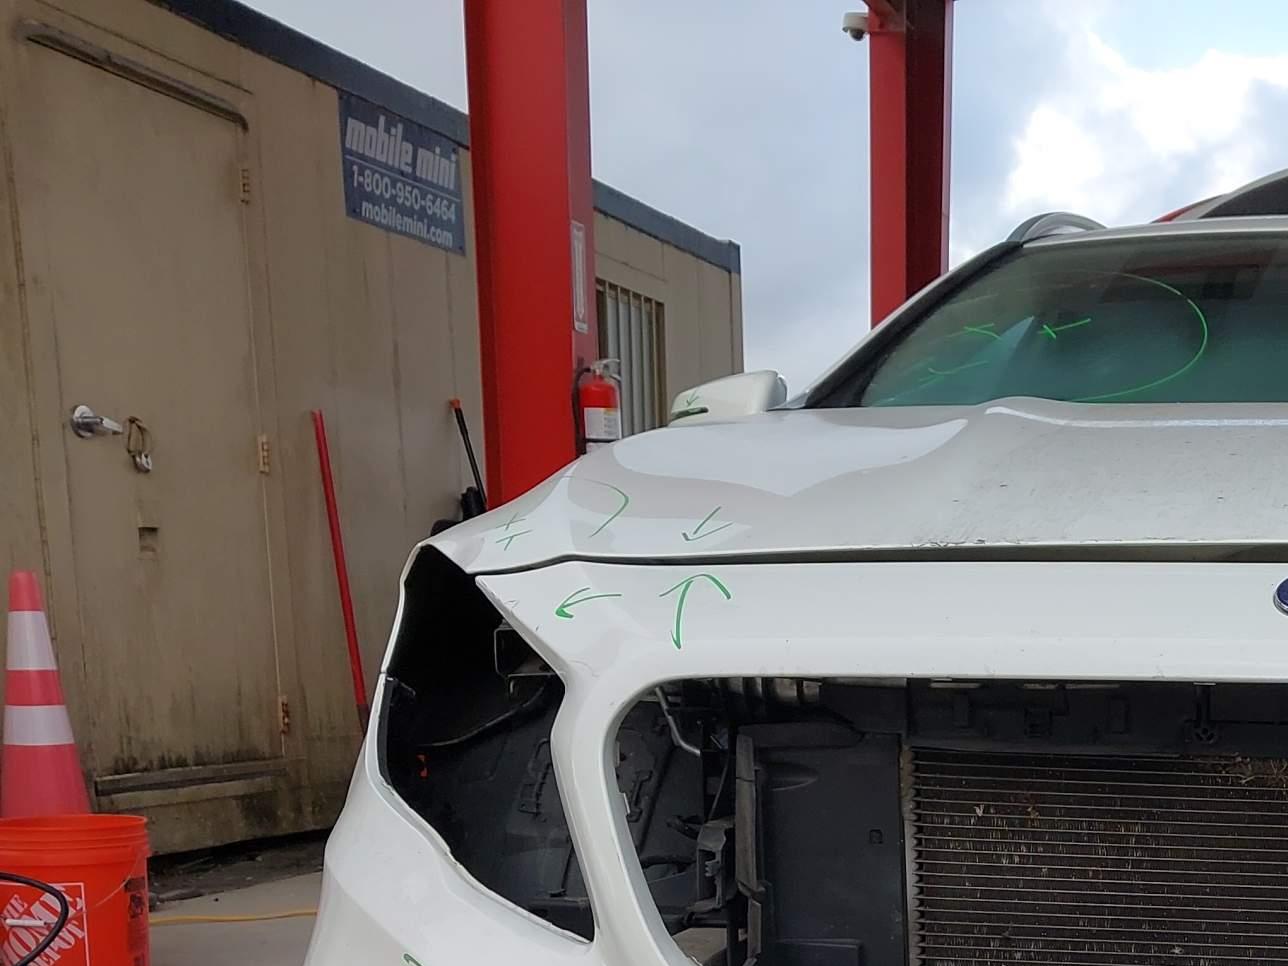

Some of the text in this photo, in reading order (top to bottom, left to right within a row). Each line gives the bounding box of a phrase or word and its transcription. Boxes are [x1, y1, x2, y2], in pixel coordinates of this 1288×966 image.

[345, 115, 458, 190] mobile mini
[352, 165, 456, 224] 1-800-950-6464
[361, 200, 453, 247] mobilemini.com
